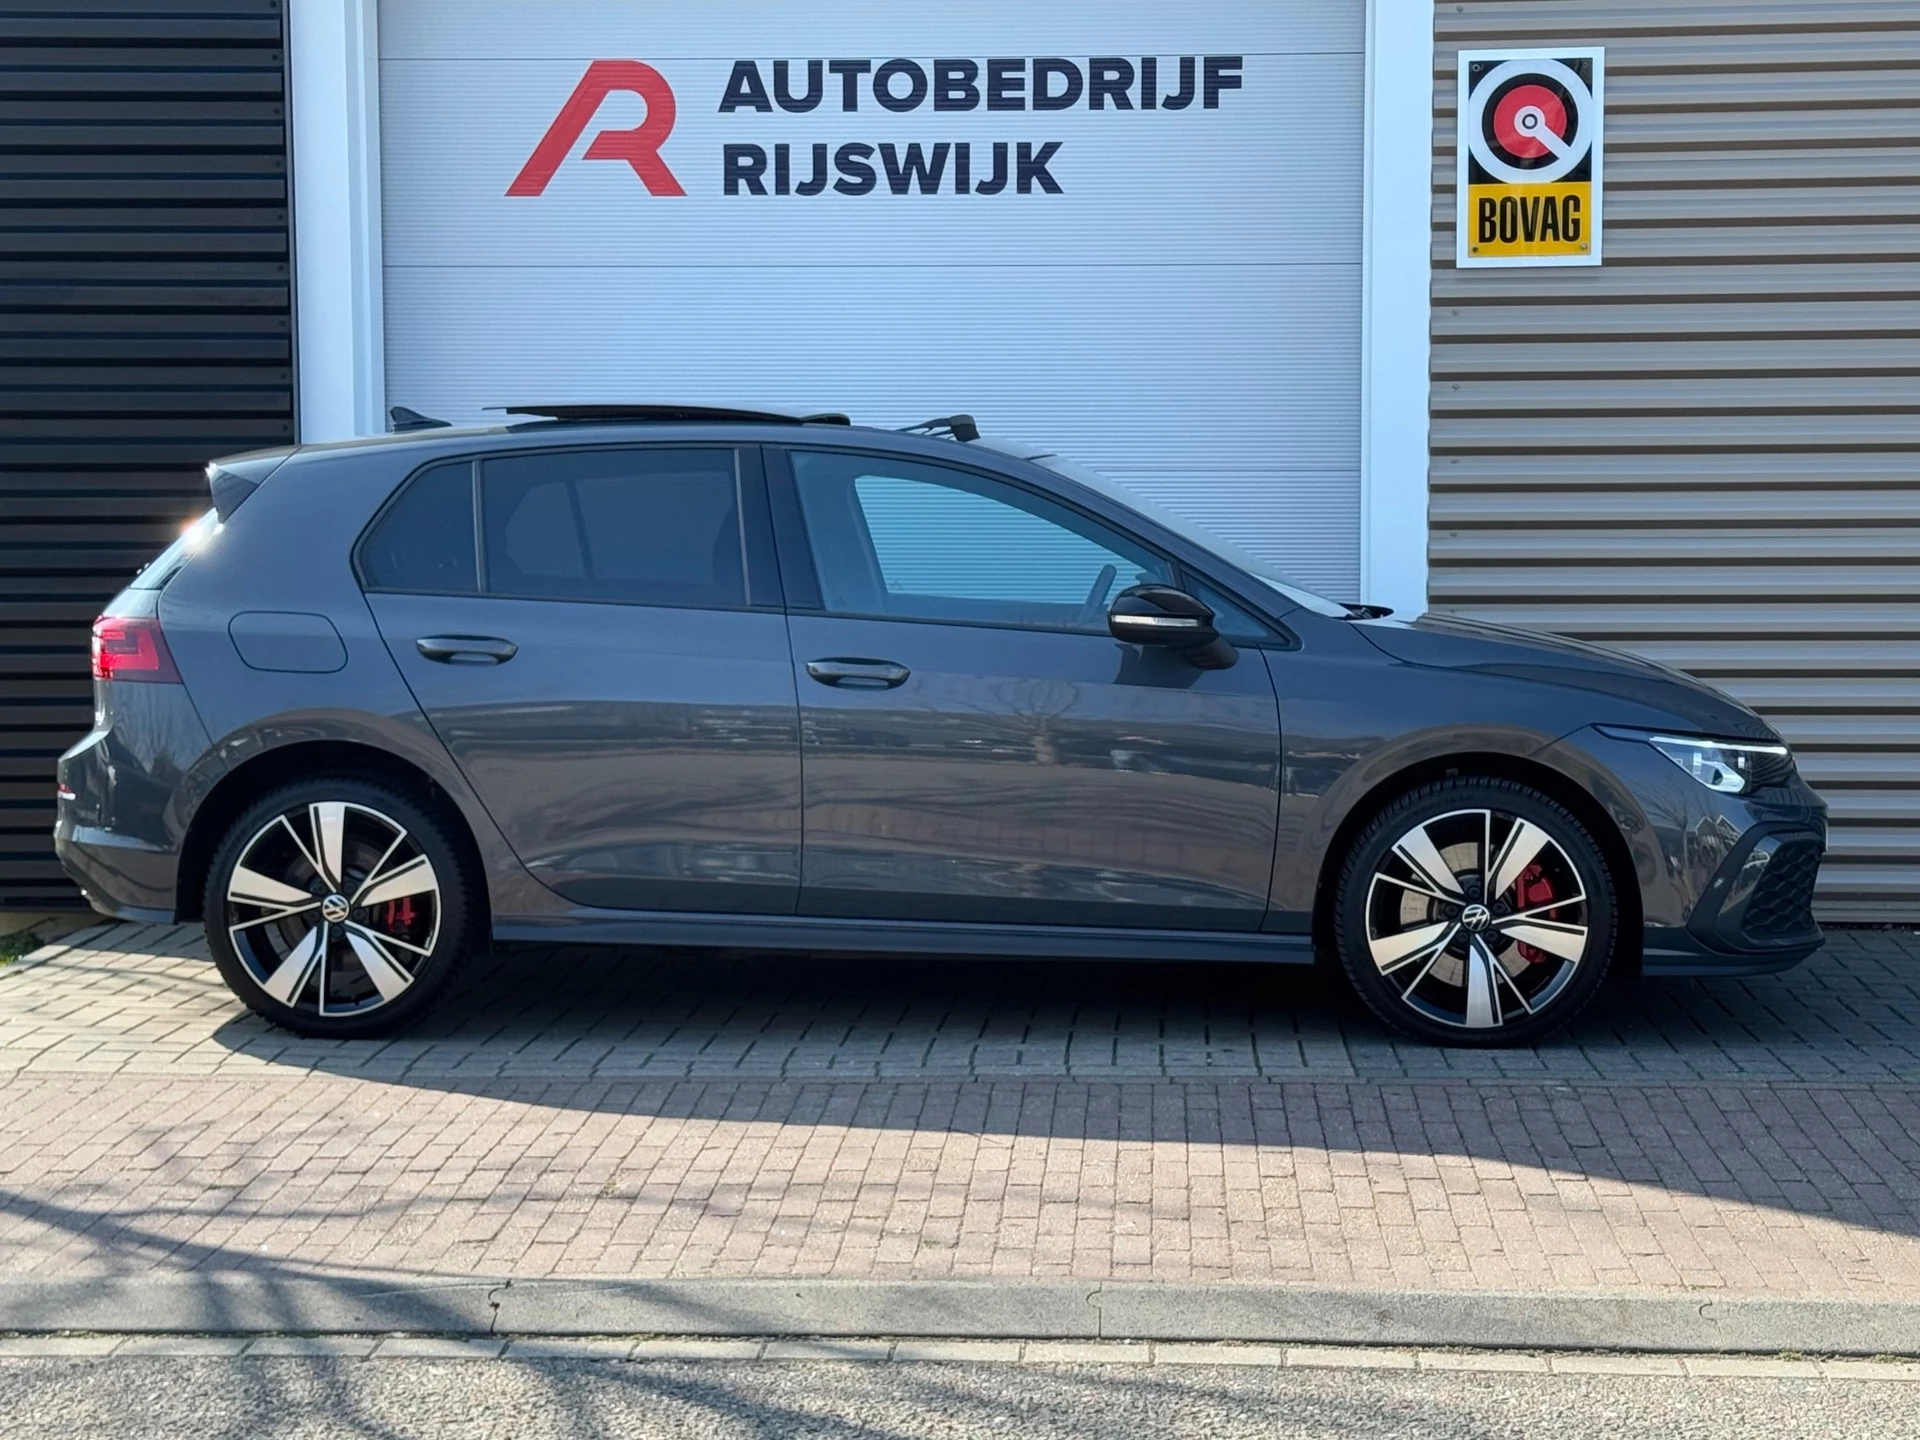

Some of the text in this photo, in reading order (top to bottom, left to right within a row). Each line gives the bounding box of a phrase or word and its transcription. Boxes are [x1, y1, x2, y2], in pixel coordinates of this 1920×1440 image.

[718, 55, 1243, 114] AUTOBEDRIJF
[723, 141, 1064, 197] RIJSWIJK
[1478, 194, 1581, 244] BOVAG
